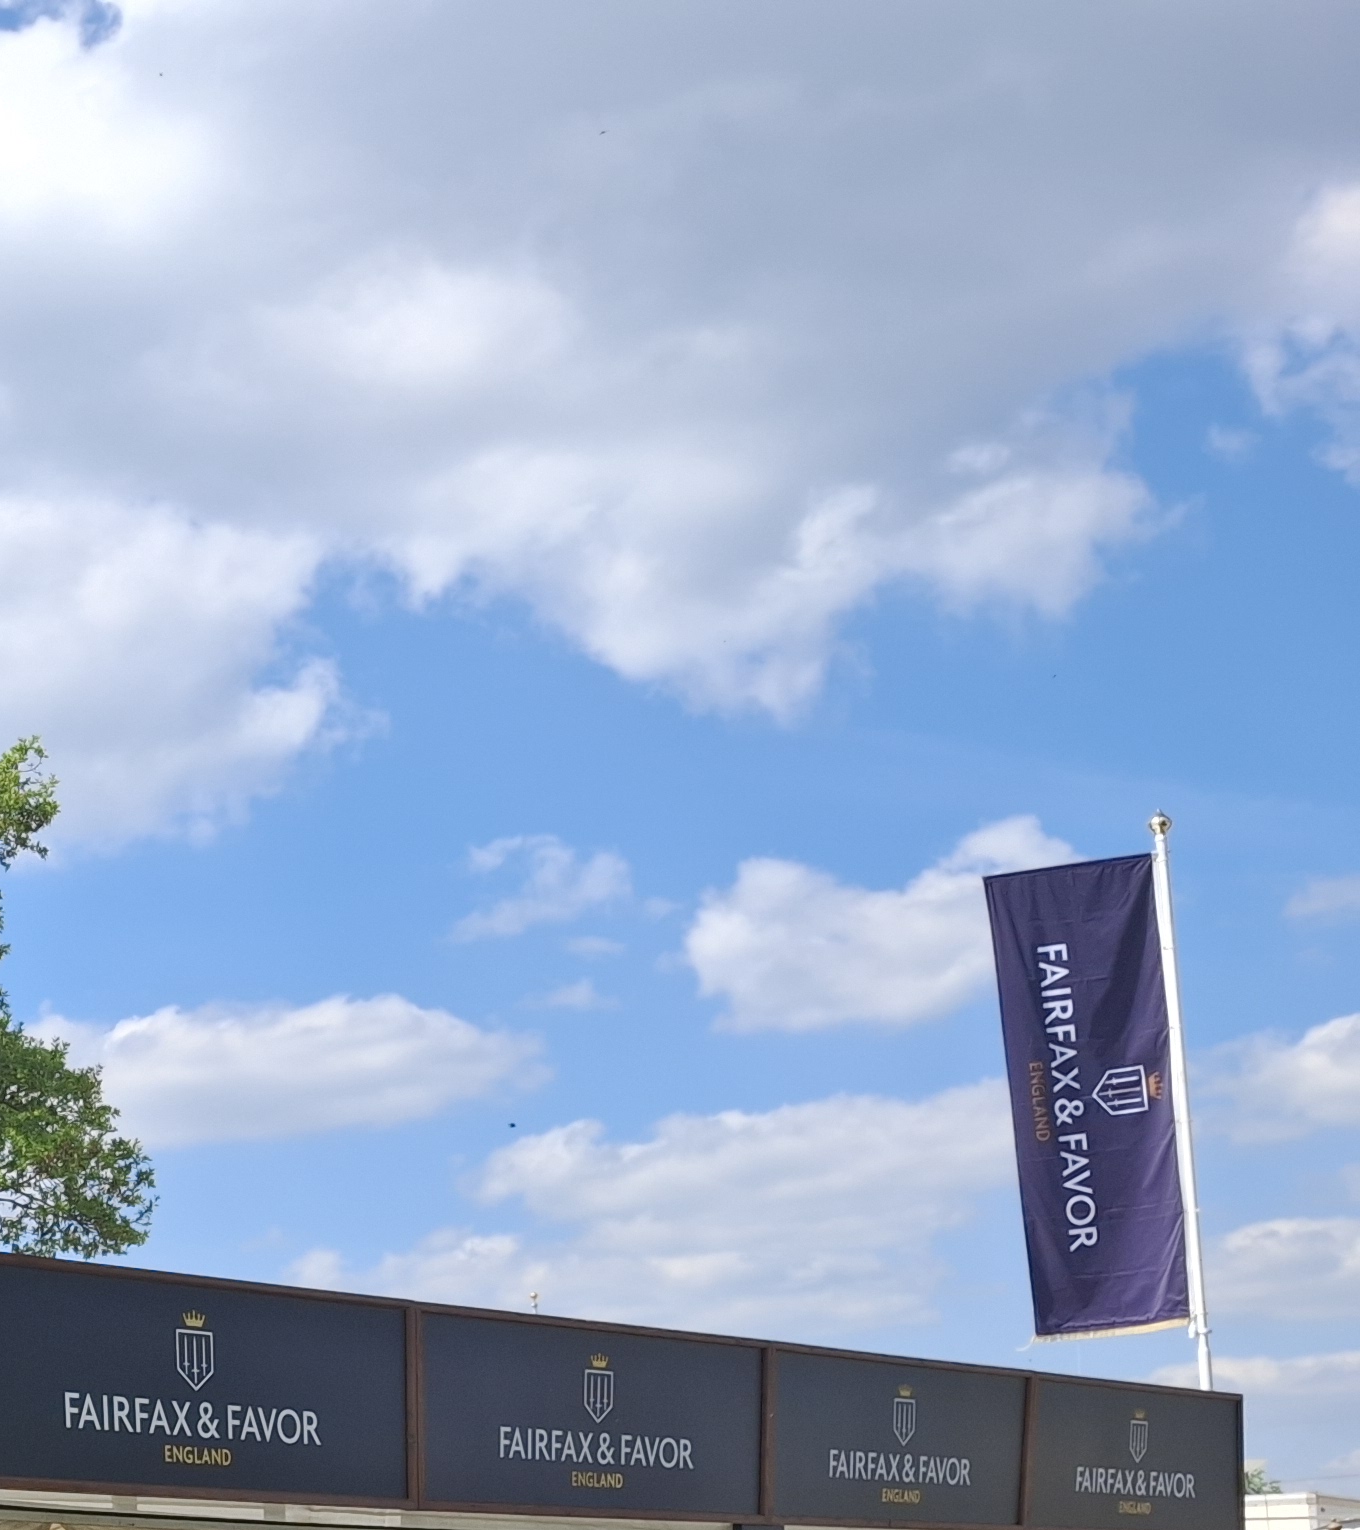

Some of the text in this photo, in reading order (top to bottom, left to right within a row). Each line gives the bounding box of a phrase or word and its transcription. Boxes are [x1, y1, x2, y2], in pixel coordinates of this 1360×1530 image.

[1028, 1060, 1051, 1142] ENGLAND
[1037, 942, 1098, 1253] FAIRFAX & FAVOR
[63, 1391, 322, 1446] FAIRFAX & FAVOR
[164, 1445, 231, 1467] ENGLAND
[499, 1425, 694, 1470] FAIRFAX & FAVOR
[571, 1470, 623, 1489] ENGLAND
[828, 1449, 971, 1486] FAIRFAX & FAVOR
[1075, 1466, 1196, 1498] FAIRFAX & FAVOR
[882, 1488, 920, 1504] ENGLAND
[1118, 1501, 1151, 1515] ENGLAND
